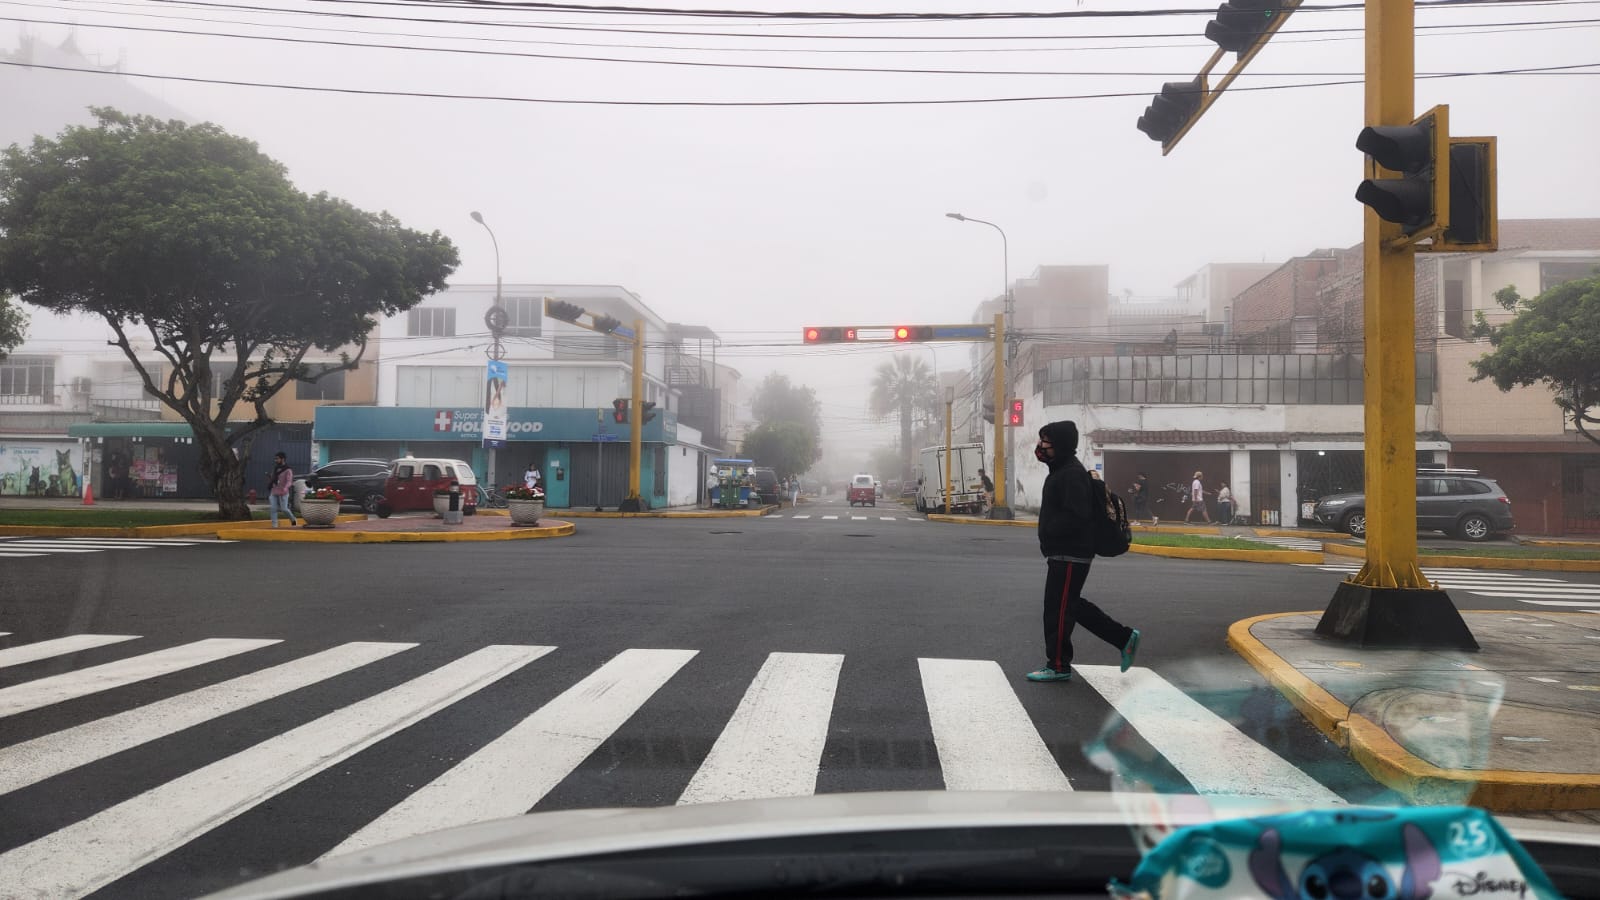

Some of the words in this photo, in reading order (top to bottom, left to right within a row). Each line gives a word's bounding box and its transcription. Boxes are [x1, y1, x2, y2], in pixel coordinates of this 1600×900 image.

[454, 410, 479, 421] Super
[1449, 820, 1487, 846] 25
[1450, 871, 1527, 900] Disney
